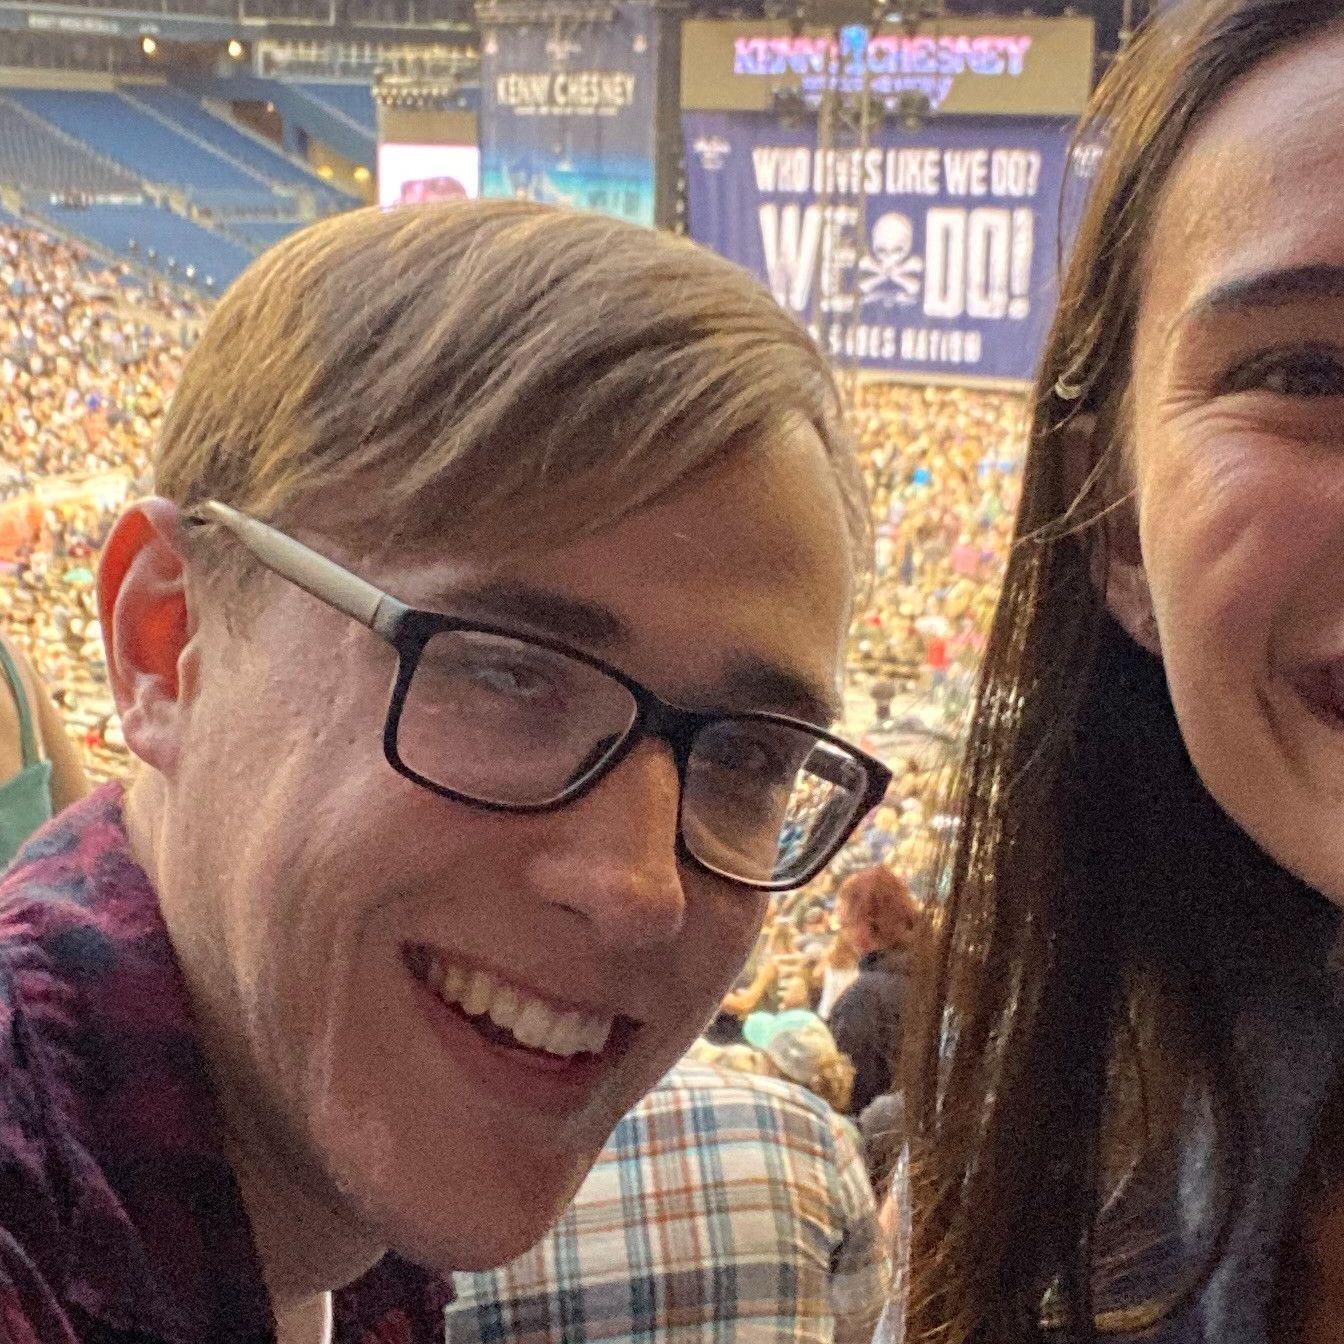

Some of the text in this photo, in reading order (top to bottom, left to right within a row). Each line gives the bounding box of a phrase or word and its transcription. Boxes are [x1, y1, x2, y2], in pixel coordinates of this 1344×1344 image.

[752, 146, 811, 193] WHO
[884, 147, 941, 196] LIKE
[943, 148, 989, 197] WE
[989, 148, 1042, 198] DO?
[758, 203, 1034, 320] WE DO!
